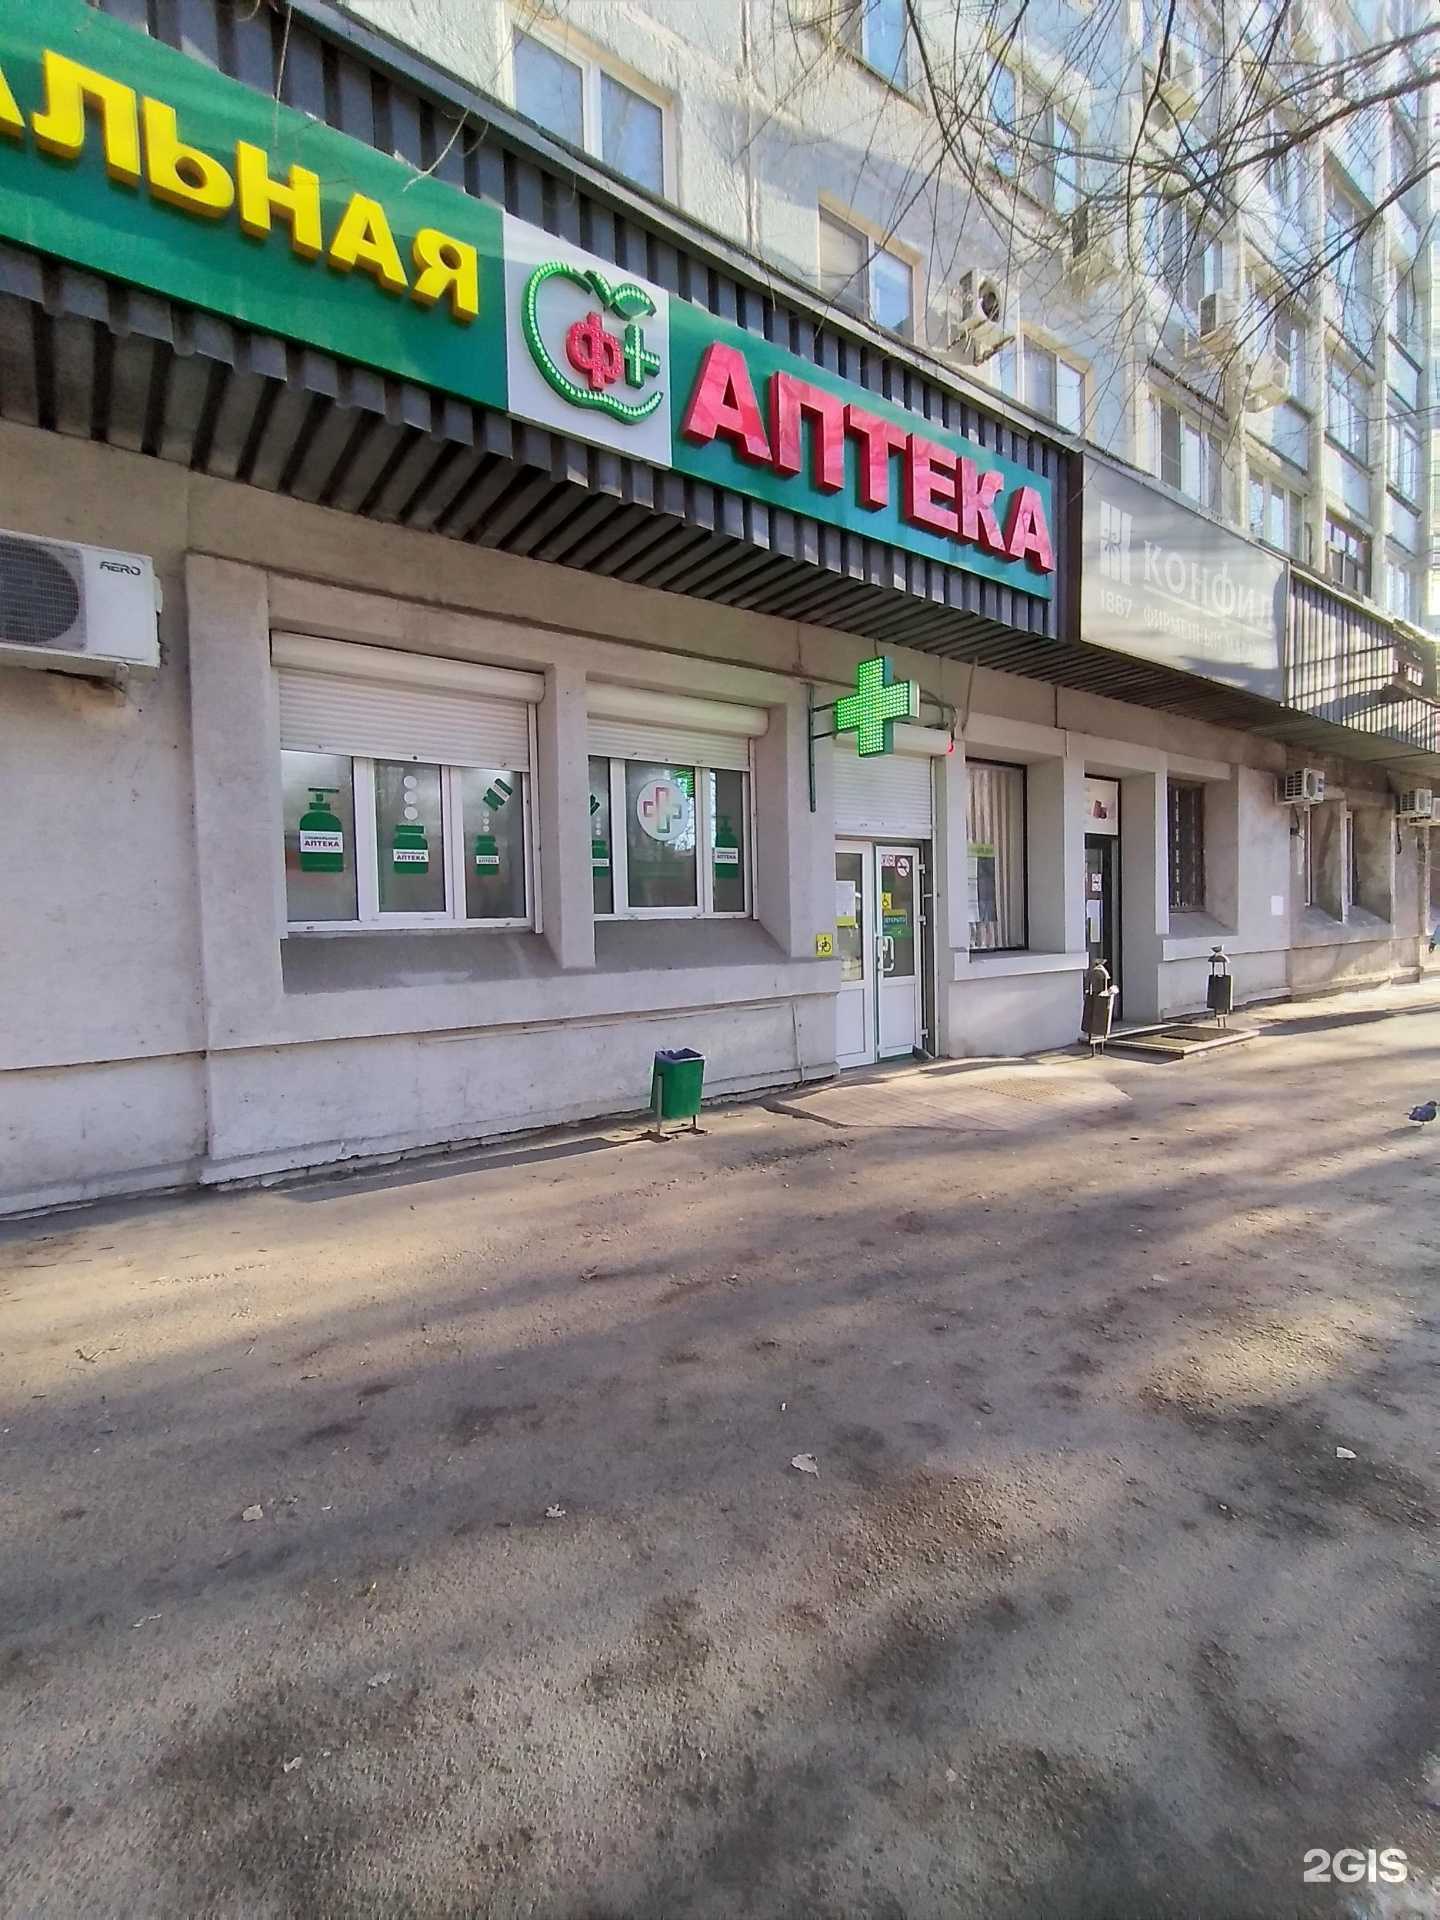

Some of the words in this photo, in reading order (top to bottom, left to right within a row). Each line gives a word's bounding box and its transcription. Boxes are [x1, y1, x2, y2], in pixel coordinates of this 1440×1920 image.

[0, 48, 480, 325] ЛЬНАЯ
[682, 340, 1055, 574] АПТЕКА
[100, 561, 142, 576] AERO
[304, 840, 340, 848] АПТЕКА
